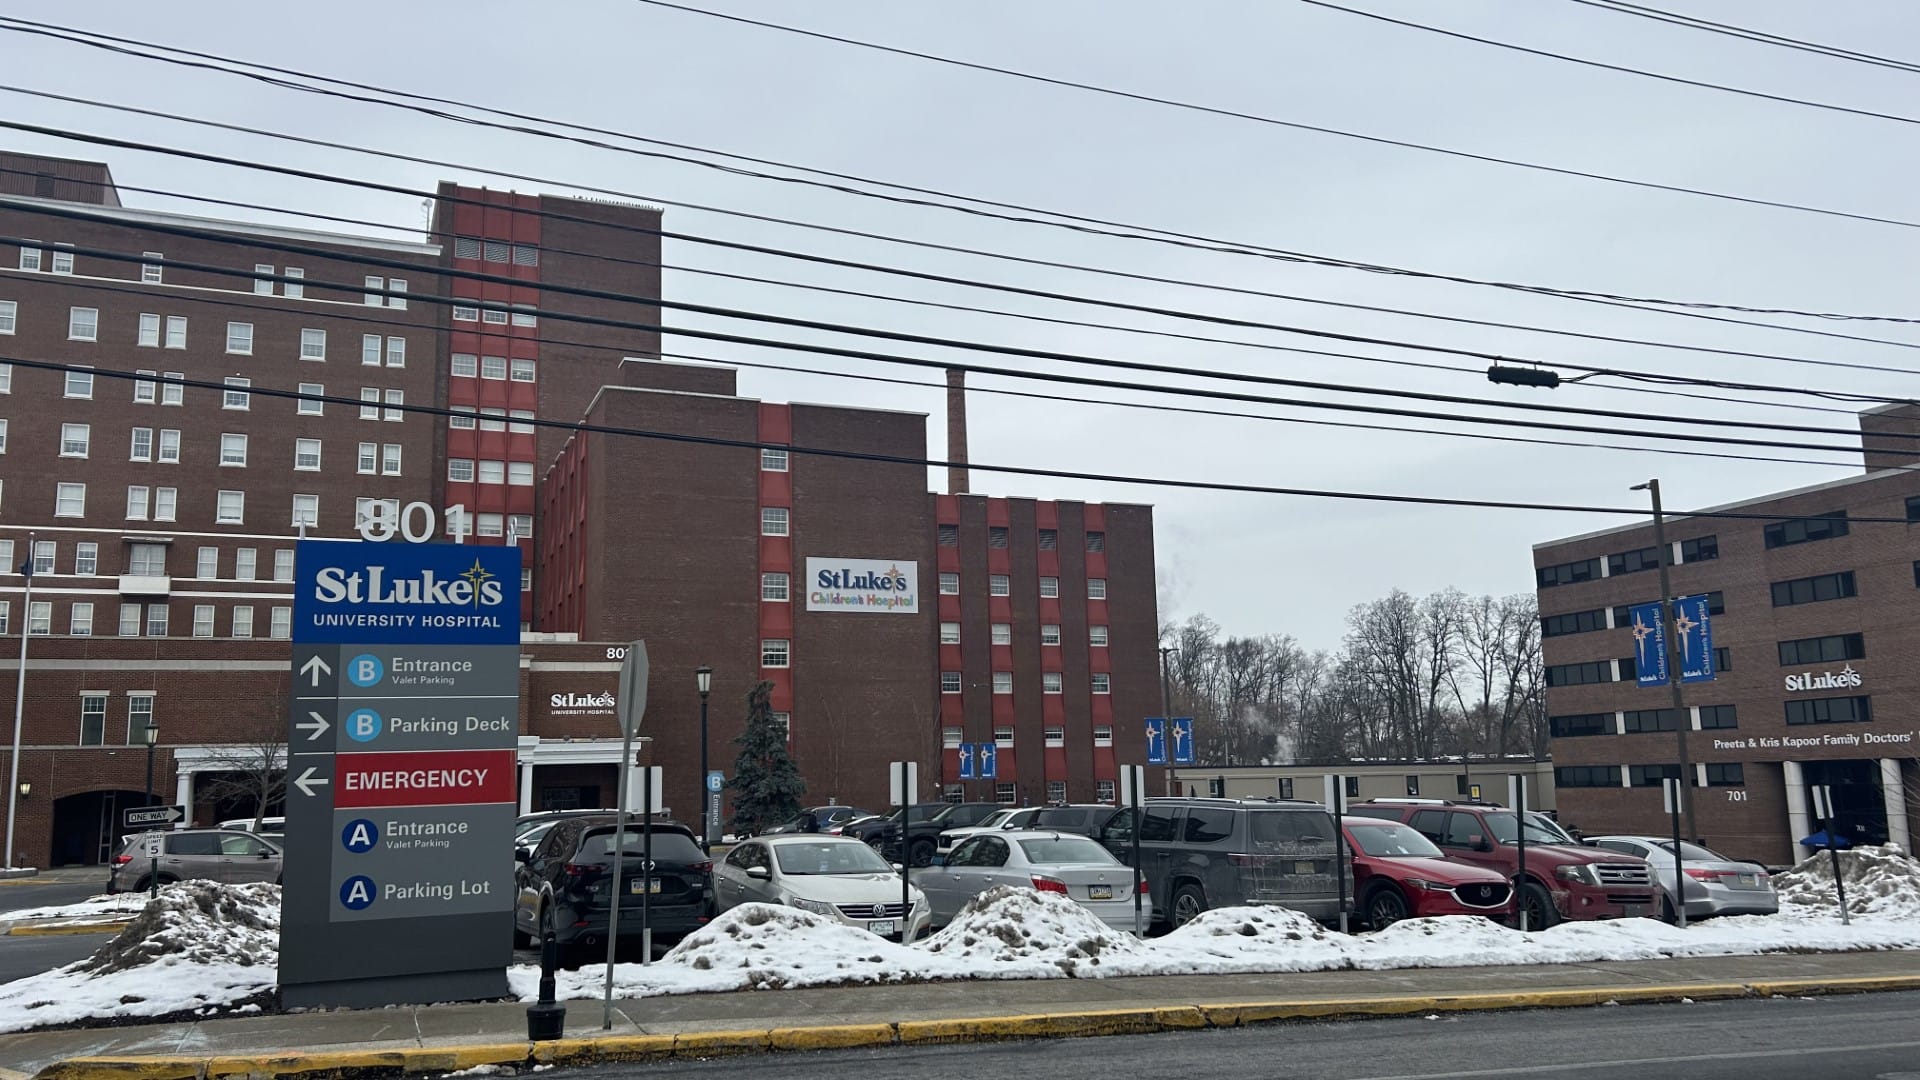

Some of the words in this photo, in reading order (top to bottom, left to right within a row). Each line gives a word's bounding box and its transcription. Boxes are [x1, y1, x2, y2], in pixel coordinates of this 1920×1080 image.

[361, 499, 465, 544] 801
[866, 594, 914, 610] Hospital
[313, 613, 415, 627] UNIVERSITY
[422, 615, 501, 628] HOSPITAL
[358, 661, 375, 681] B
[392, 658, 472, 672] Entrance
[392, 676, 416, 685] Valet
[420, 676, 455, 685] Parking
[357, 714, 374, 735] B
[390, 717, 458, 735] Parking
[465, 716, 510, 731] Deck
[1714, 740, 1745, 749] Preeta
[1748, 738, 1756, 747] &
[1760, 737, 1779, 747] Kris
[1783, 736, 1820, 748] Kapoor
[1823, 733, 1860, 745] Family
[1864, 731, 1914, 744] Doctors'
[345, 769, 489, 790] EMERGENCY
[711, 776, 721, 789] B
[1727, 790, 1747, 801] 701
[131, 813, 149, 821] ONE
[150, 811, 167, 820] WAY
[712, 794, 721, 826] Entrance
[349, 824, 370, 846] A
[386, 820, 468, 836] Entrance
[151, 845, 159, 855] 5
[386, 841, 411, 849] Valet
[415, 839, 449, 849] Parking
[347, 881, 369, 903] A
[384, 881, 453, 900] Parking
[461, 880, 490, 895] Lot
